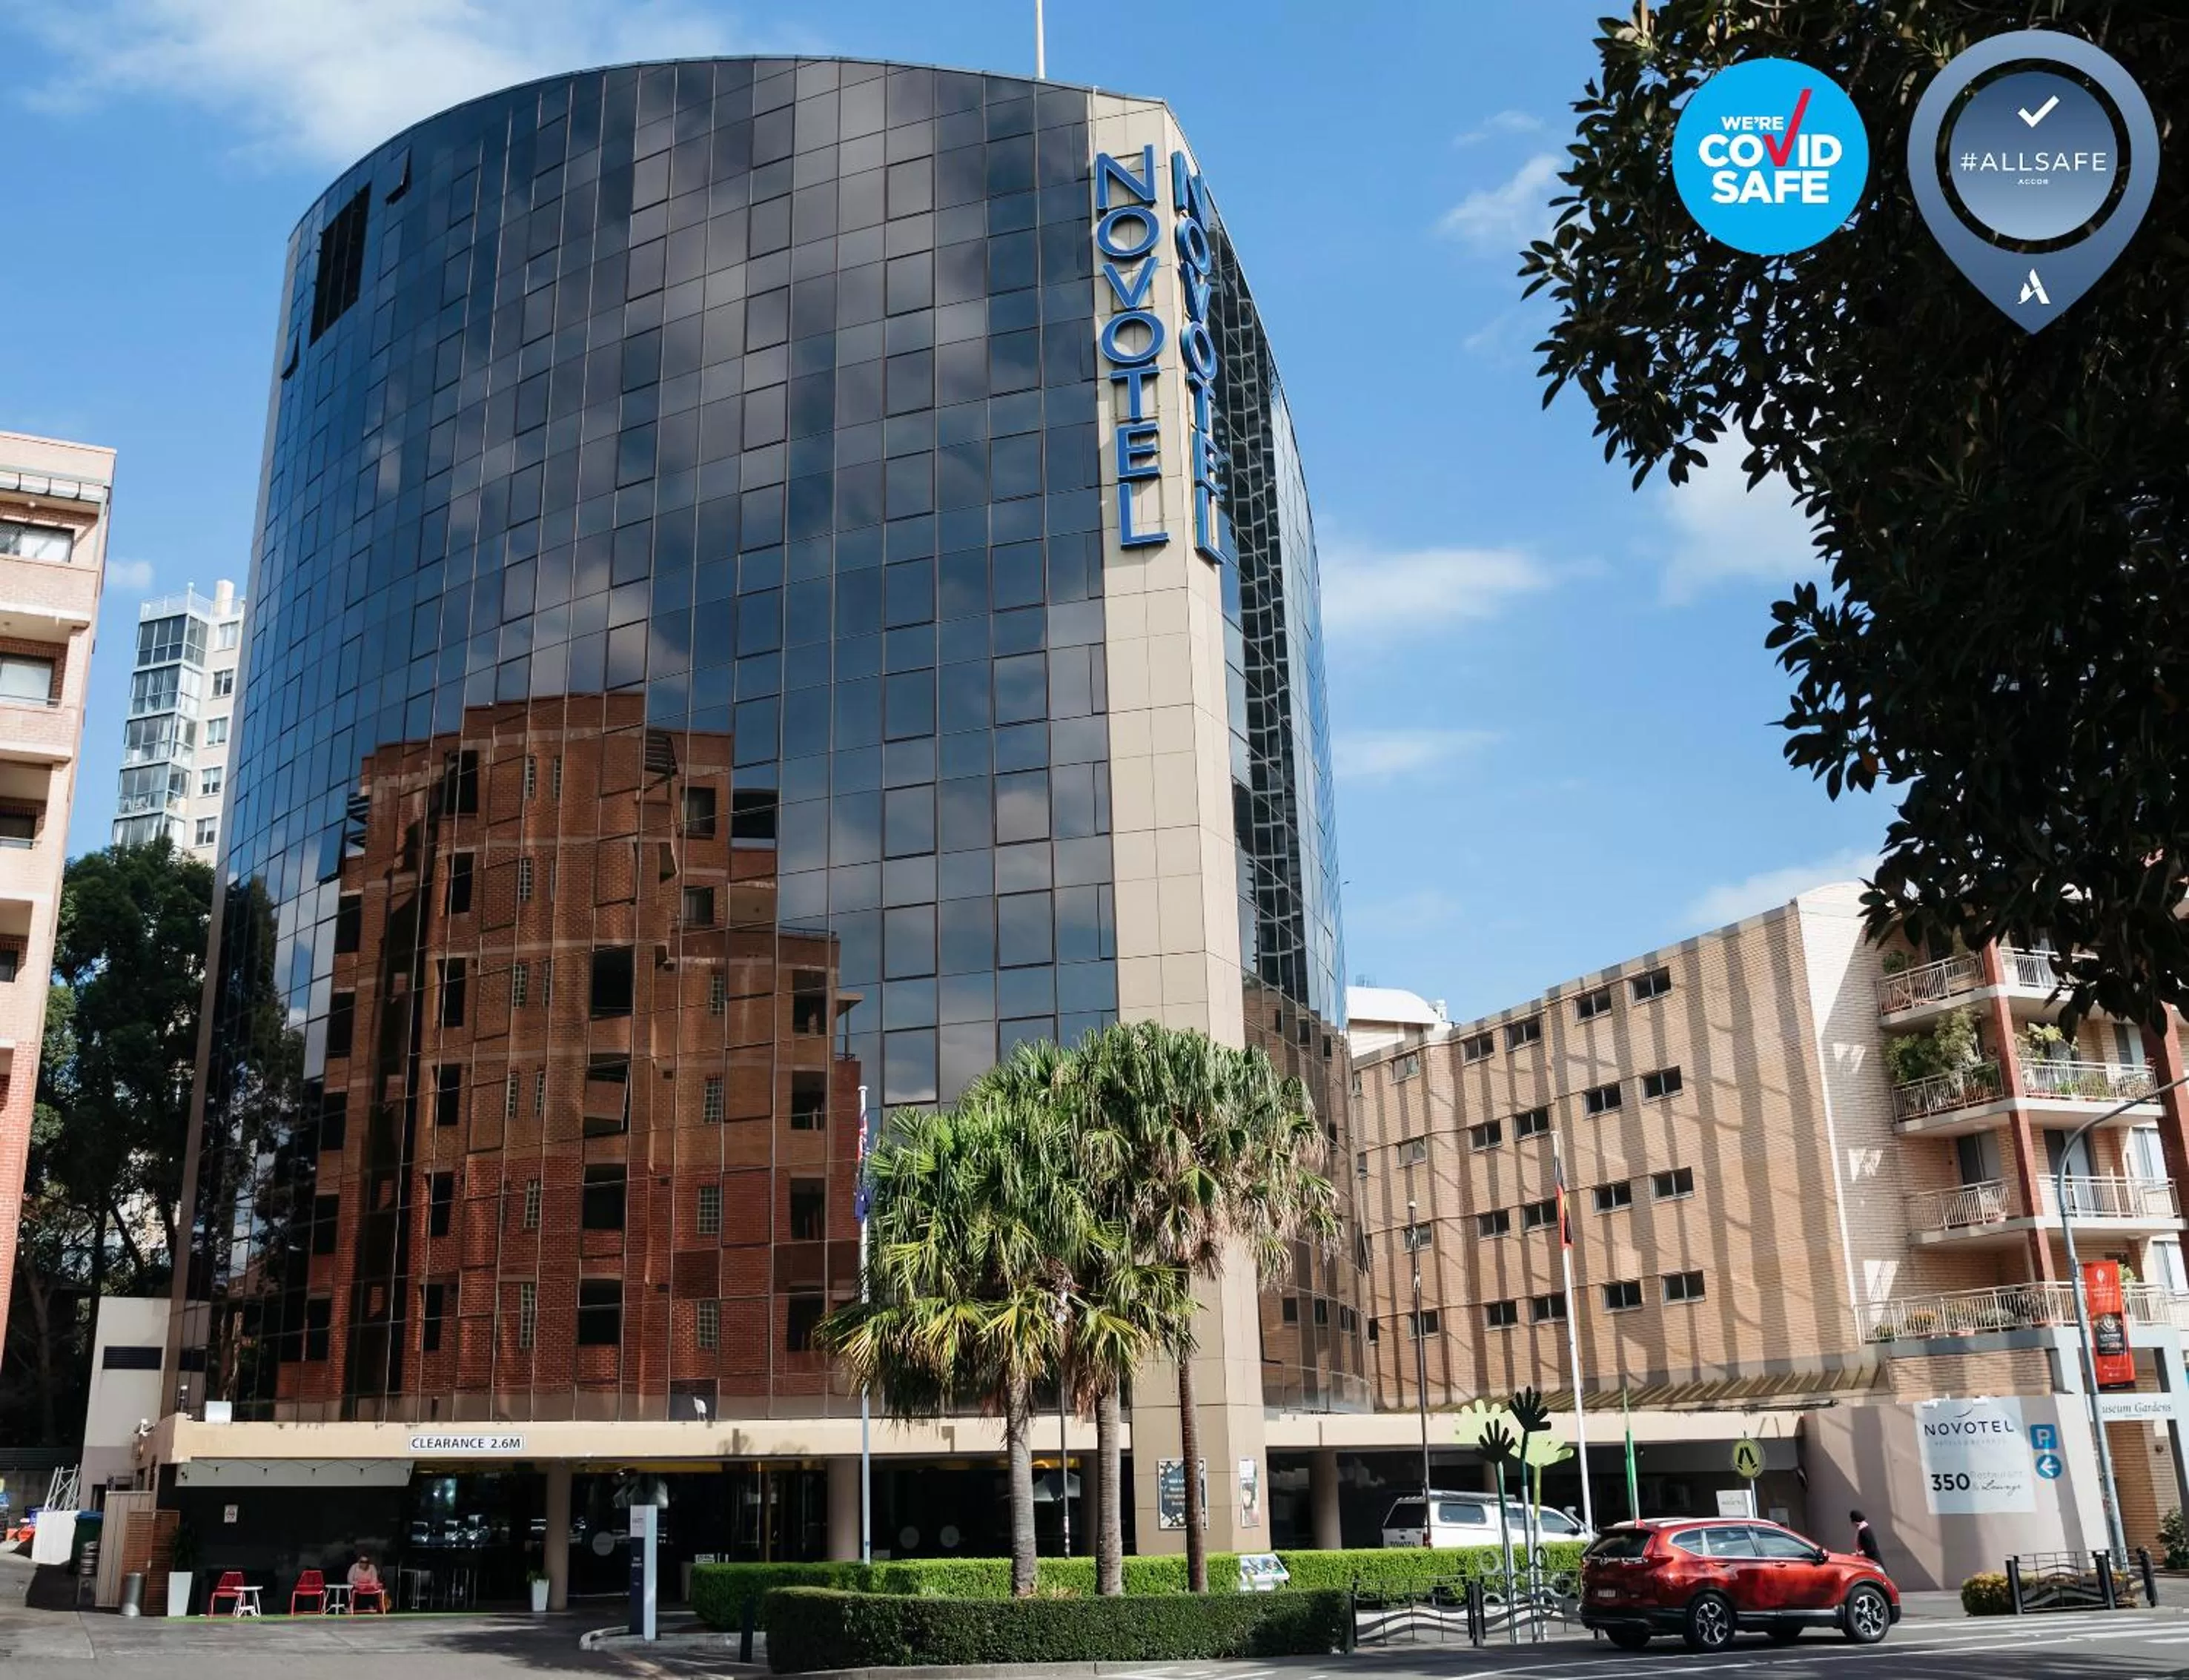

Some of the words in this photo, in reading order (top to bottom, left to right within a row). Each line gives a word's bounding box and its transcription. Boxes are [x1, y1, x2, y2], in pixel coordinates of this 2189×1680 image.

[1096, 143, 1170, 550] NOVOTEL
[1171, 150, 1226, 565] NOVOTEL
[2134, 1402, 2171, 1413] Gardens
[1924, 1420, 2015, 1437] NOVOTEL
[411, 1437, 485, 1449] CLEARANCE
[490, 1438, 520, 1449] 2.6M
[1930, 1472, 1971, 1492] 350
